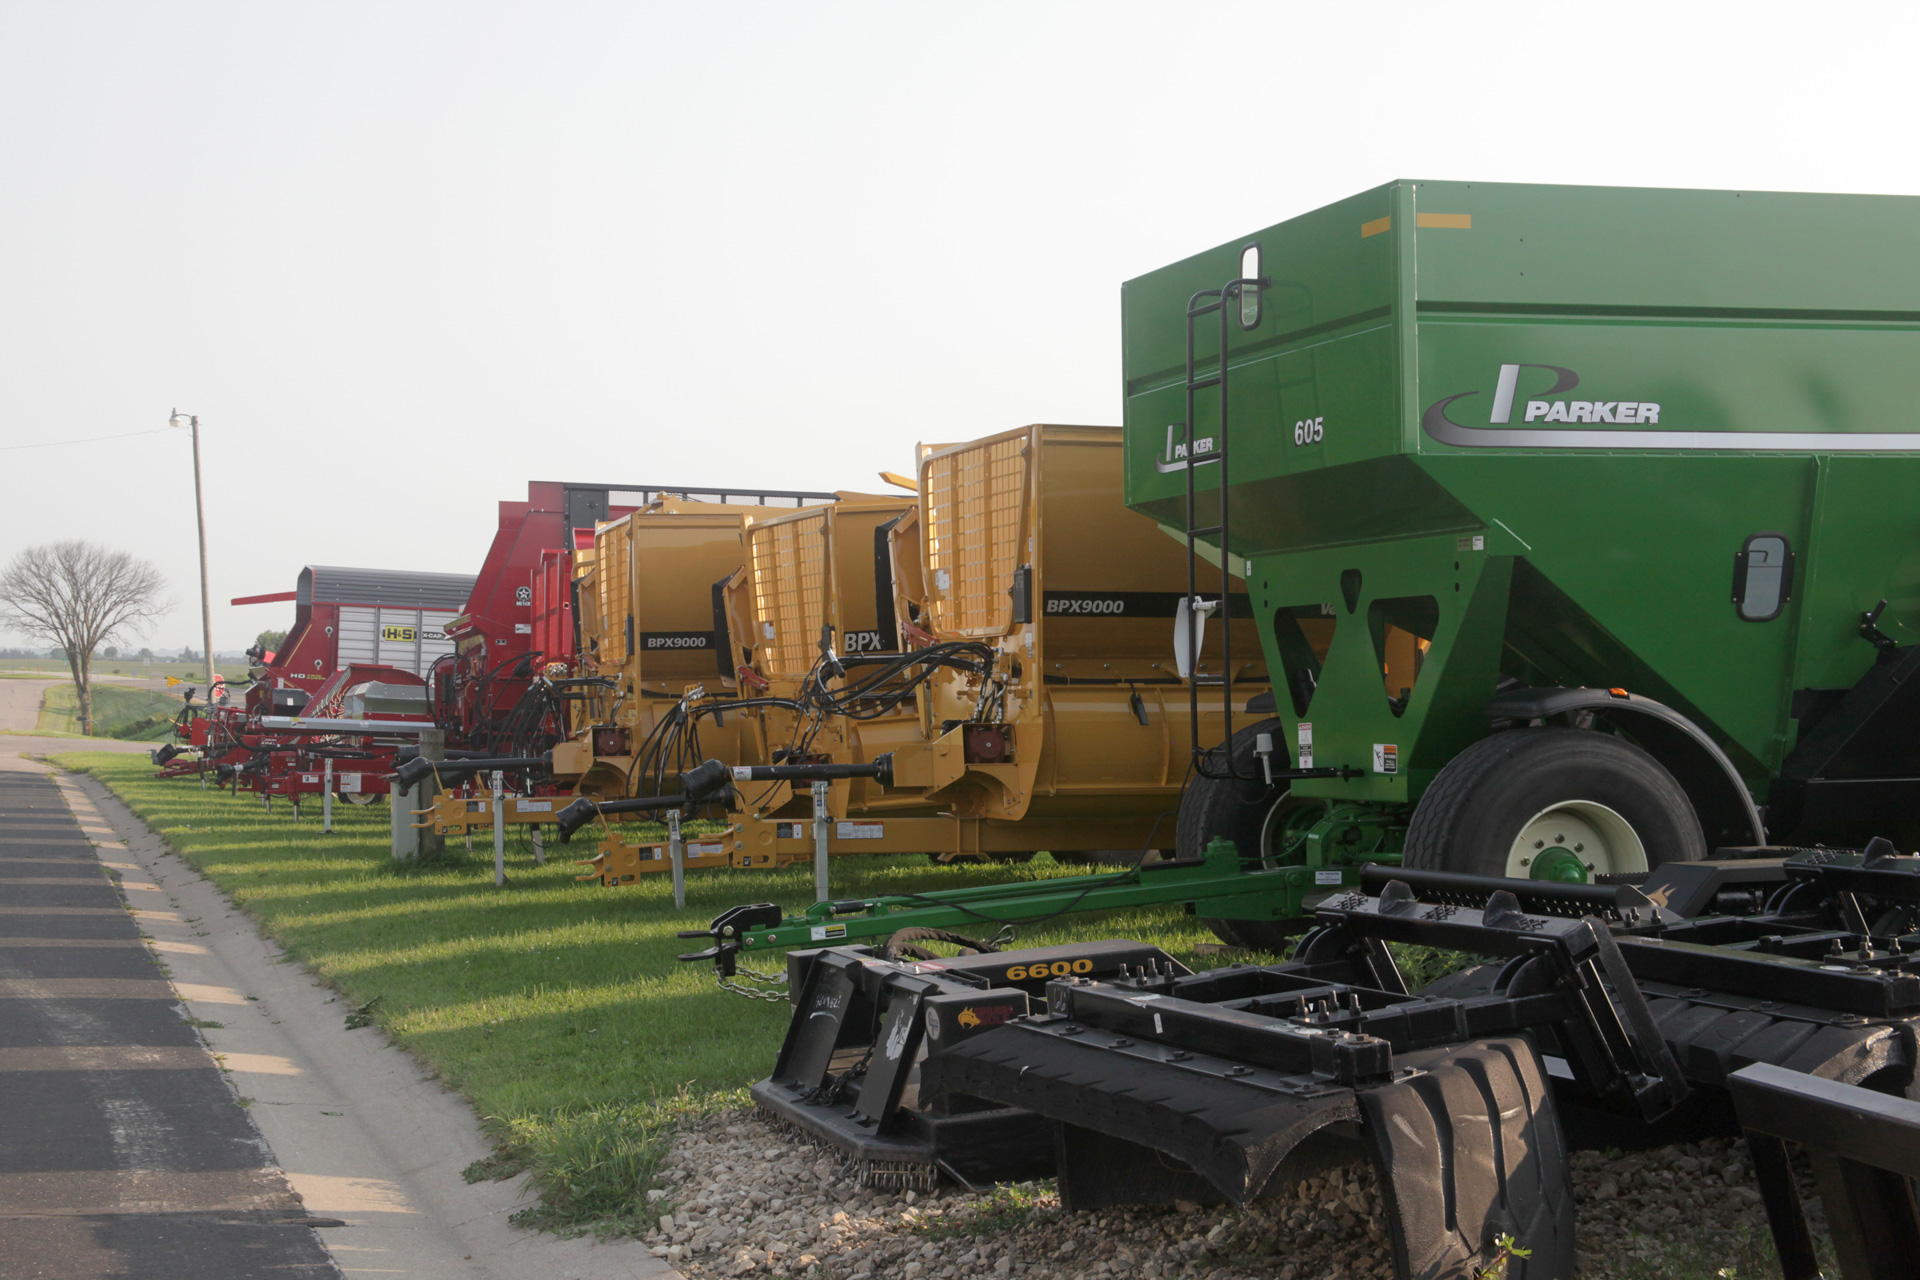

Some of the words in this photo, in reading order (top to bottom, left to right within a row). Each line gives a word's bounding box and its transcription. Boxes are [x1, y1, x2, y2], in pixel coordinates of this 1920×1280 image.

[1523, 400, 1661, 425] PARKER
[1294, 416, 1324, 448] 605
[1175, 437, 1214, 459] PAKER
[1046, 599, 1125, 614] BPX9000
[386, 628, 413, 640] H&S
[647, 636, 707, 648] BPX9000
[844, 631, 882, 652] BPX
[1006, 959, 1094, 981] 6600
